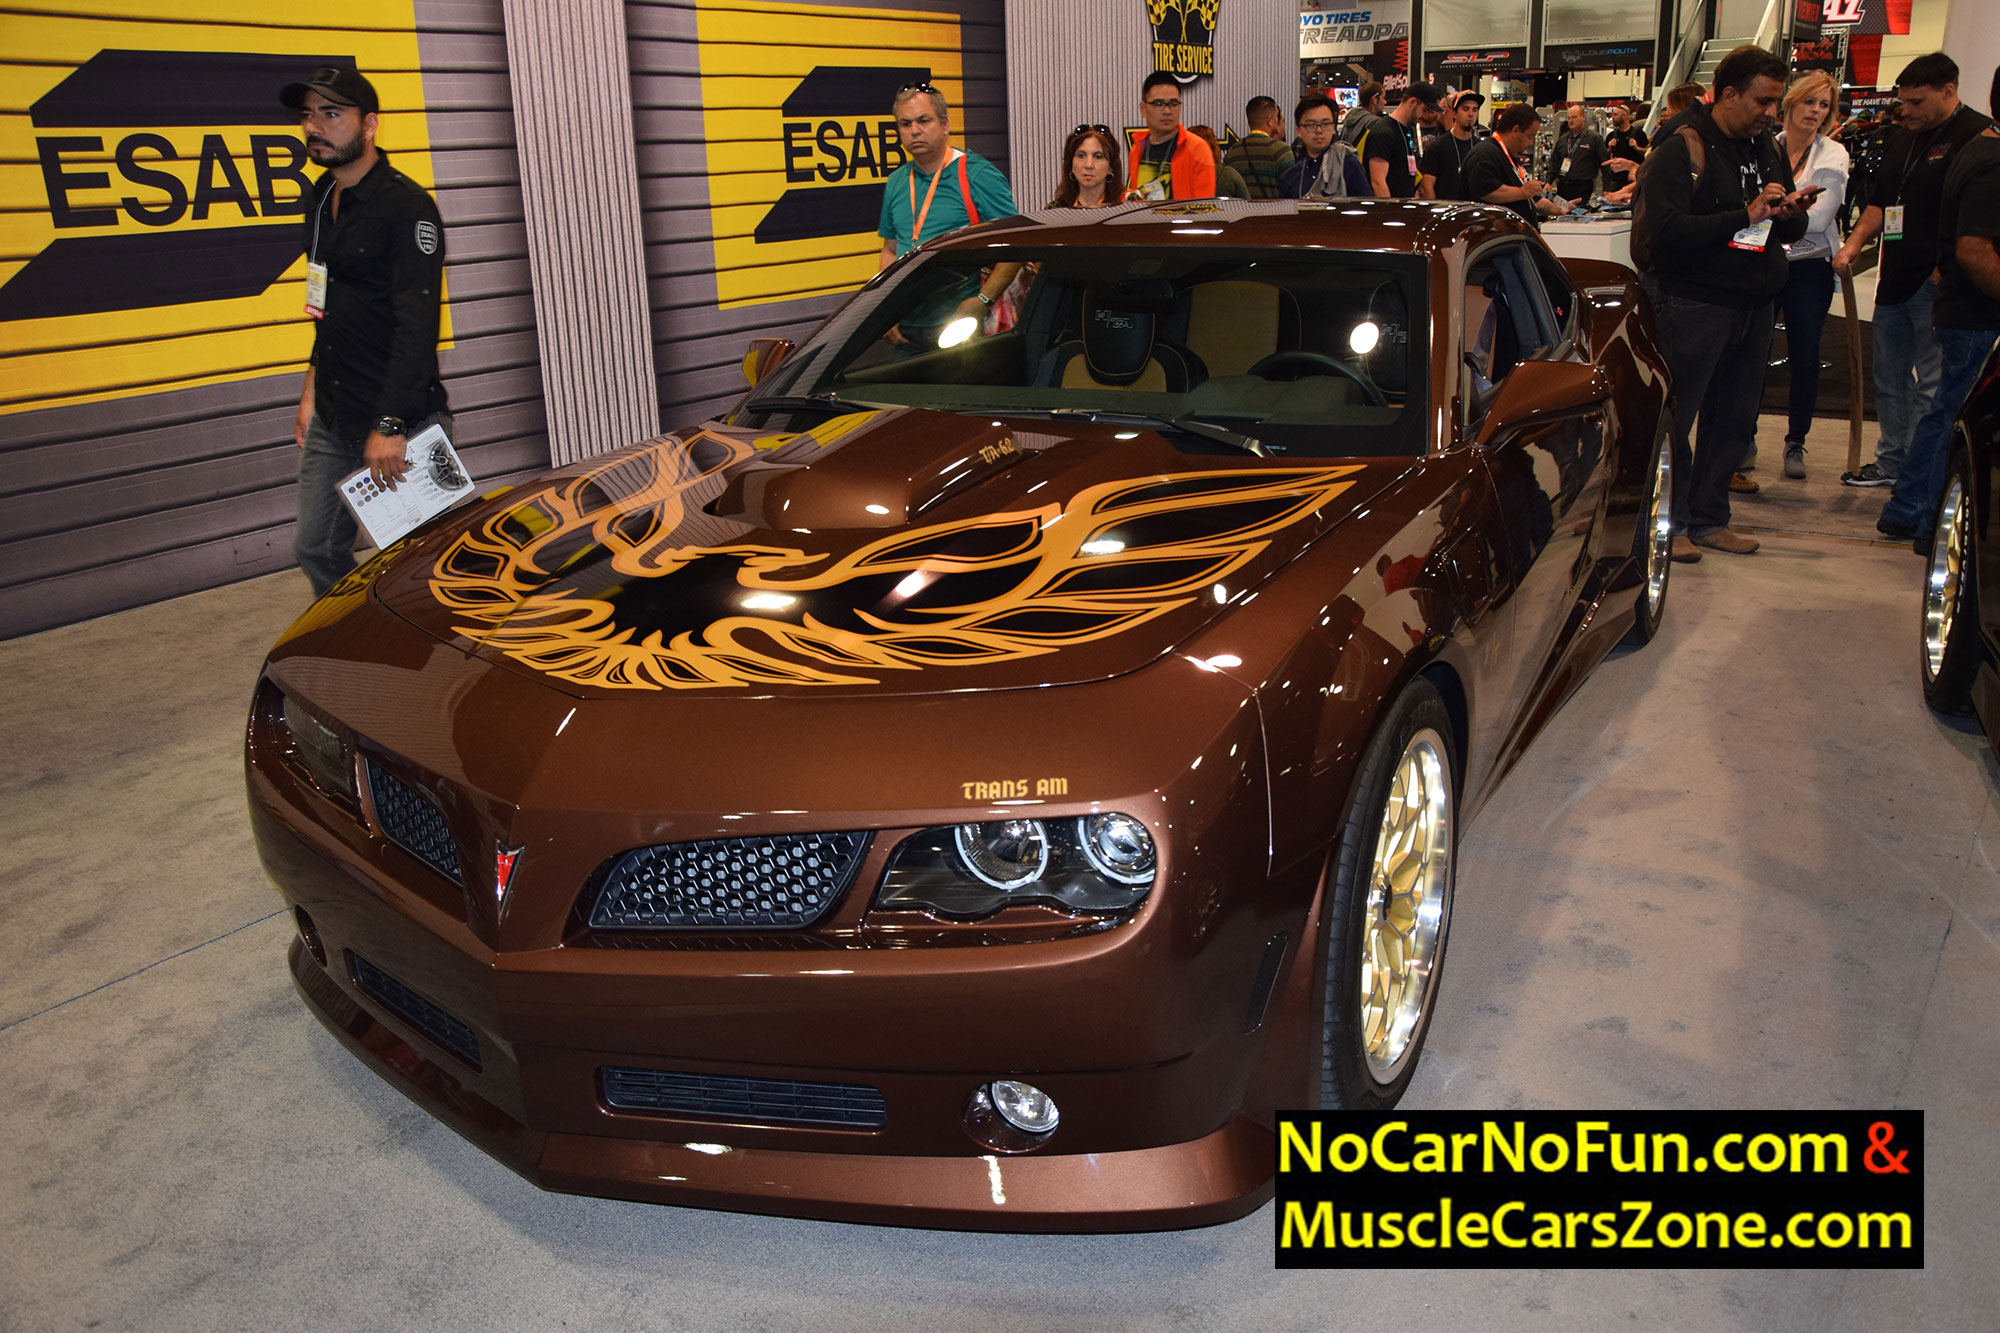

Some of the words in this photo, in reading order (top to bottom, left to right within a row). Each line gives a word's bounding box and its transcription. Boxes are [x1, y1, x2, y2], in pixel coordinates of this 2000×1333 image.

[1300, 14, 1324, 26] YO
[1326, 11, 1372, 25] TIRES
[1153, 43, 1175, 72] TIRE
[1176, 44, 1213, 74] SERVICE
[783, 120, 907, 183] ESAB
[36, 133, 318, 229] ESAB
[961, 780, 1028, 800] TRANS
[1037, 778, 1068, 796] AM
